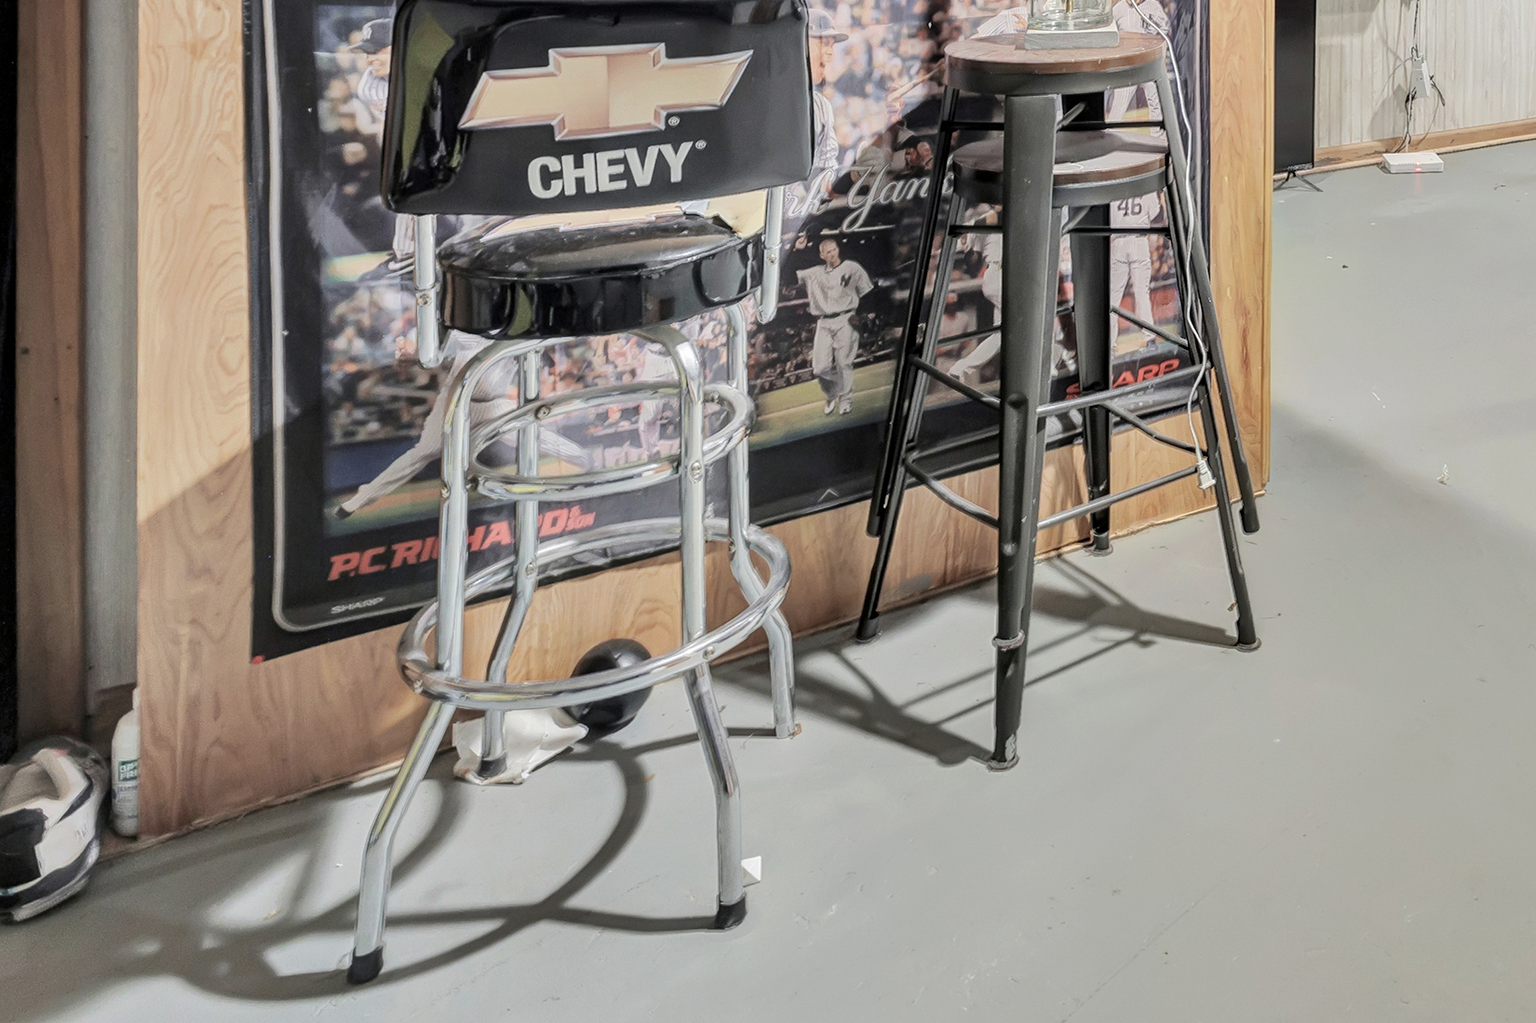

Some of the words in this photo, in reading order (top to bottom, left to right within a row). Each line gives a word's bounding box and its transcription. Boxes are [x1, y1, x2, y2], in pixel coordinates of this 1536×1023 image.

[527, 140, 694, 200] CHEVY
[389, 509, 569, 570] RIHAD
[331, 596, 386, 614] SHARP
